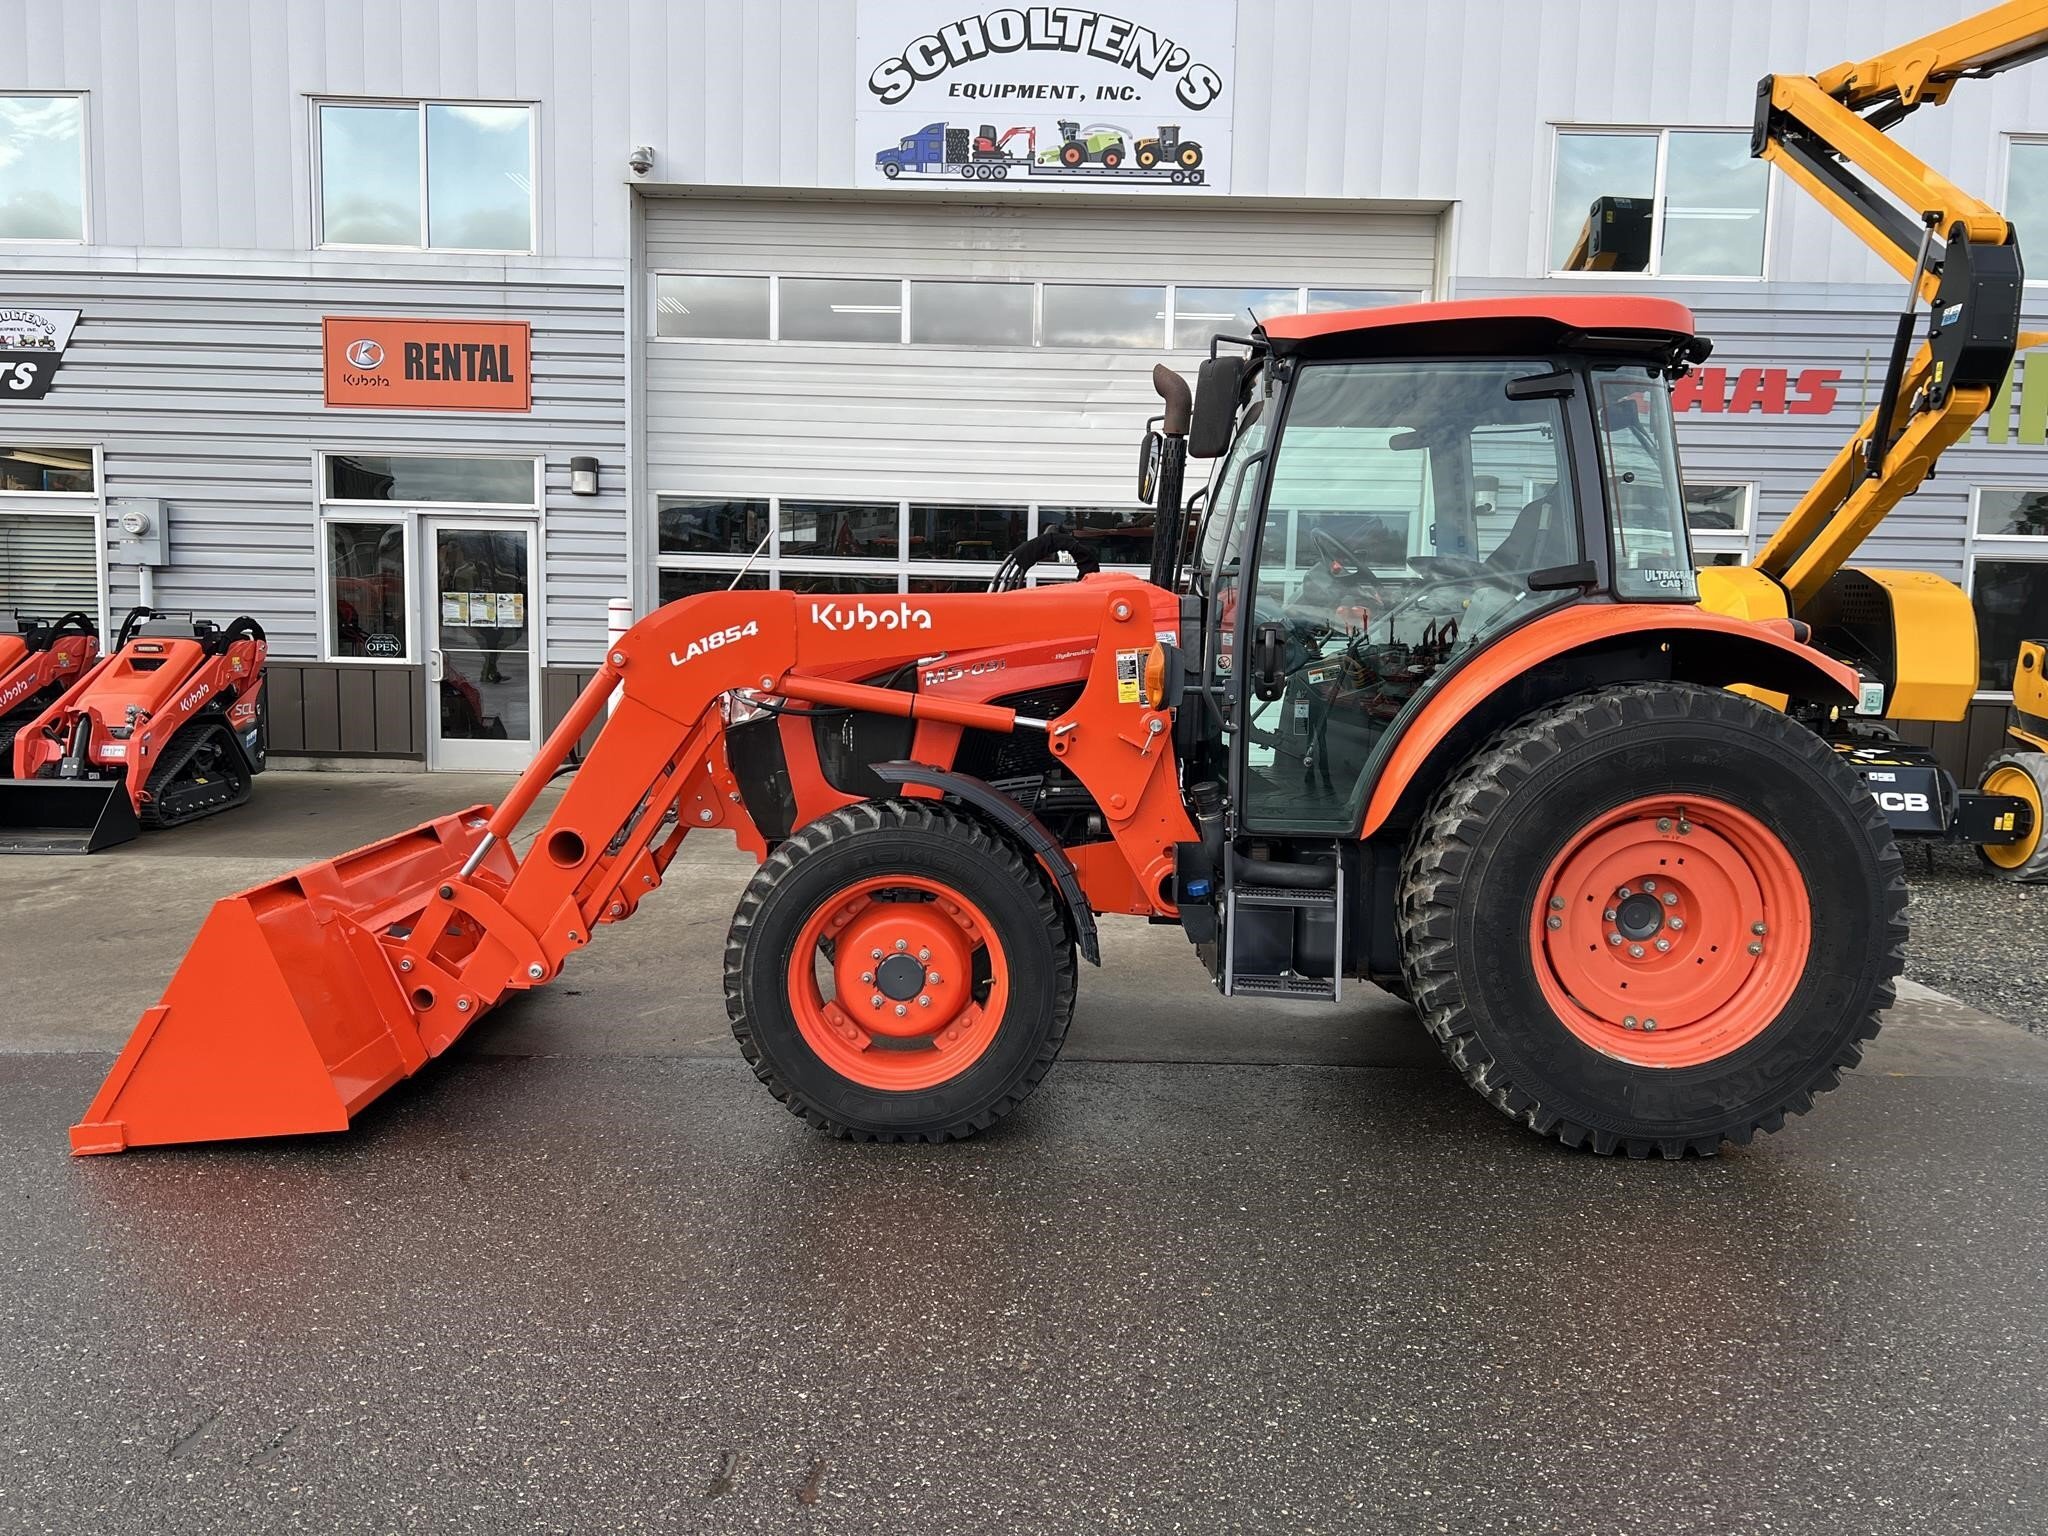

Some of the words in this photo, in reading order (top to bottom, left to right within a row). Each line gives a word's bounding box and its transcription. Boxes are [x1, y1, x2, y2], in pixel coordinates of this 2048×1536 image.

[869, 7, 1222, 110] SCHOLTEN'S
[948, 82, 1086, 102] EQUIPMENT,
[1096, 85, 1142, 101] INC.
[0, 310, 56, 334] OLTEN'S
[404, 342, 514, 383] RENTAL
[343, 374, 391, 387] Kubota
[1671, 367, 1842, 414] AAS
[811, 602, 932, 631] Kubota
[367, 643, 399, 652] OPEN
[669, 620, 760, 667] LA1854
[180, 683, 210, 712] Kubota
